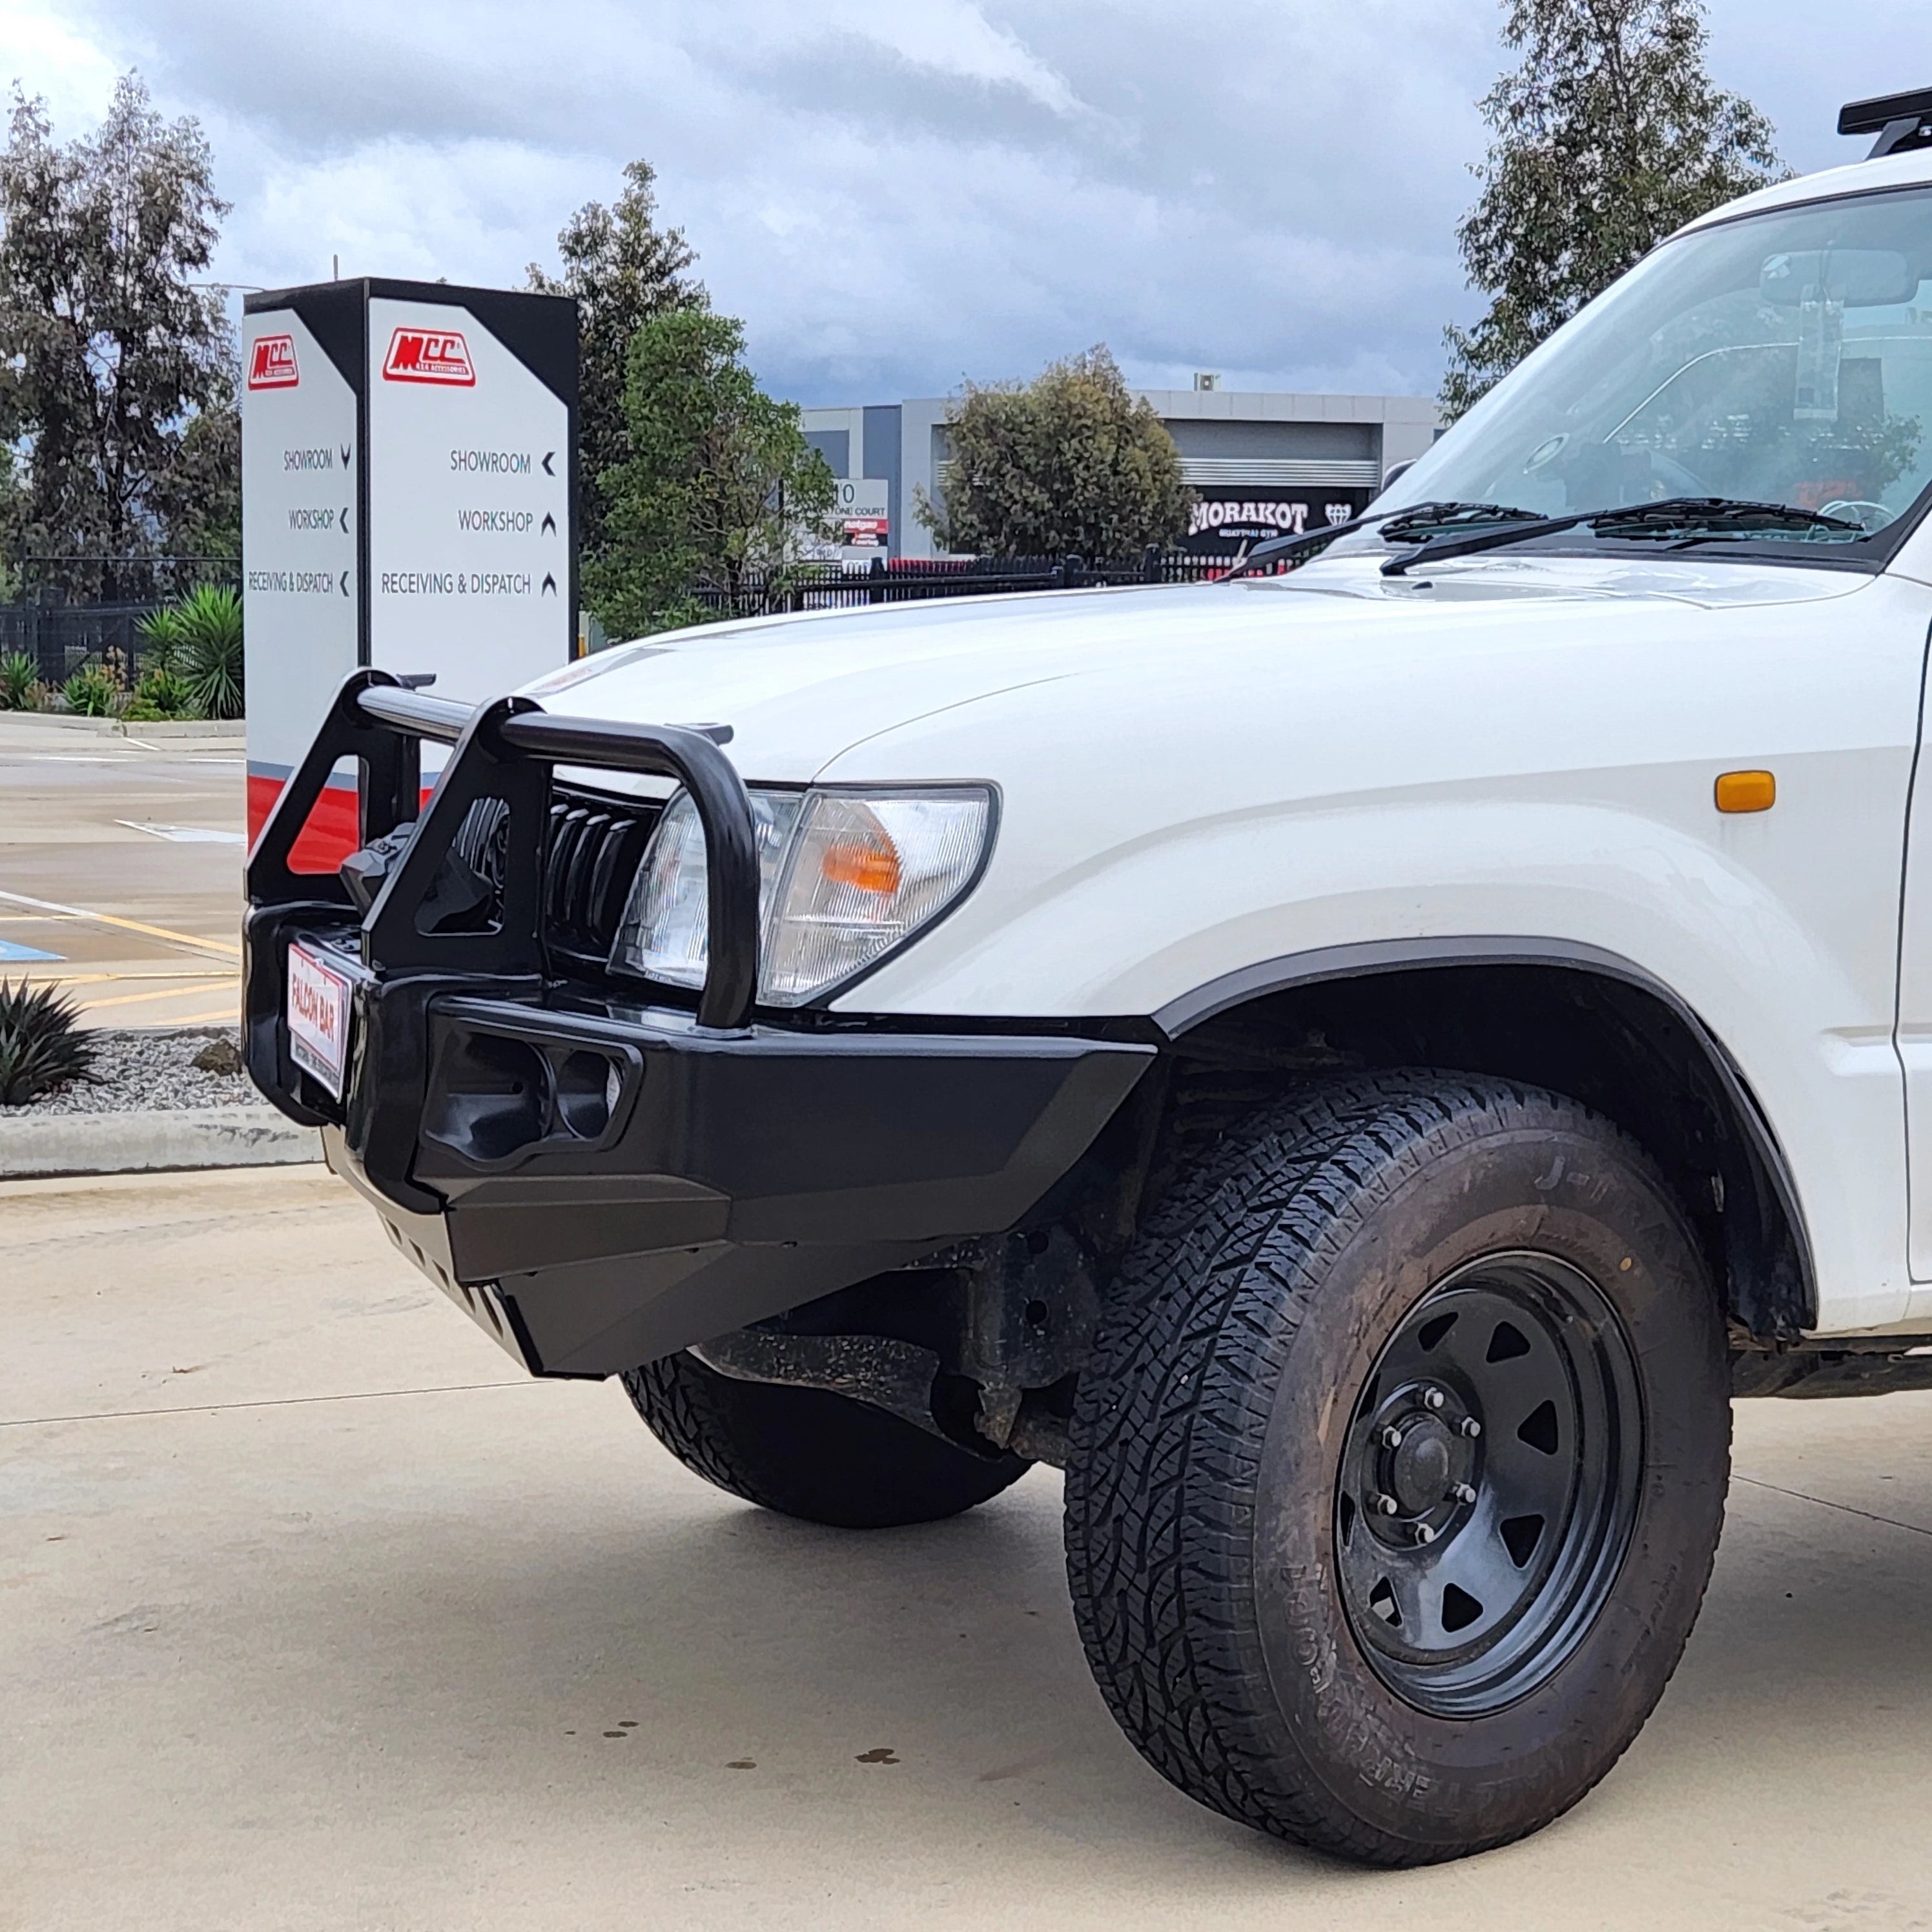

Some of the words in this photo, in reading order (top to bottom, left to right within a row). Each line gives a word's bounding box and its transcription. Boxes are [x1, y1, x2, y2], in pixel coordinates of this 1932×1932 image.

[389, 335, 466, 370] MCC
[284, 448, 333, 471] SHOWROOM
[450, 449, 531, 474] SHOWROOM
[289, 509, 334, 529] WORKSHOP
[458, 509, 533, 533] WORKSHOP
[855, 507, 885, 516] COURT
[1189, 502, 1308, 535] MORAKOT
[249, 571, 287, 592] RECEIVING
[289, 571, 294, 591] &
[296, 572, 333, 593] DISPATCH
[382, 572, 453, 594] RECEIVING
[457, 573, 467, 594] &
[471, 573, 531, 594] DISPATCH
[293, 972, 318, 1028] FALCON
[320, 995, 334, 1043] BAR
